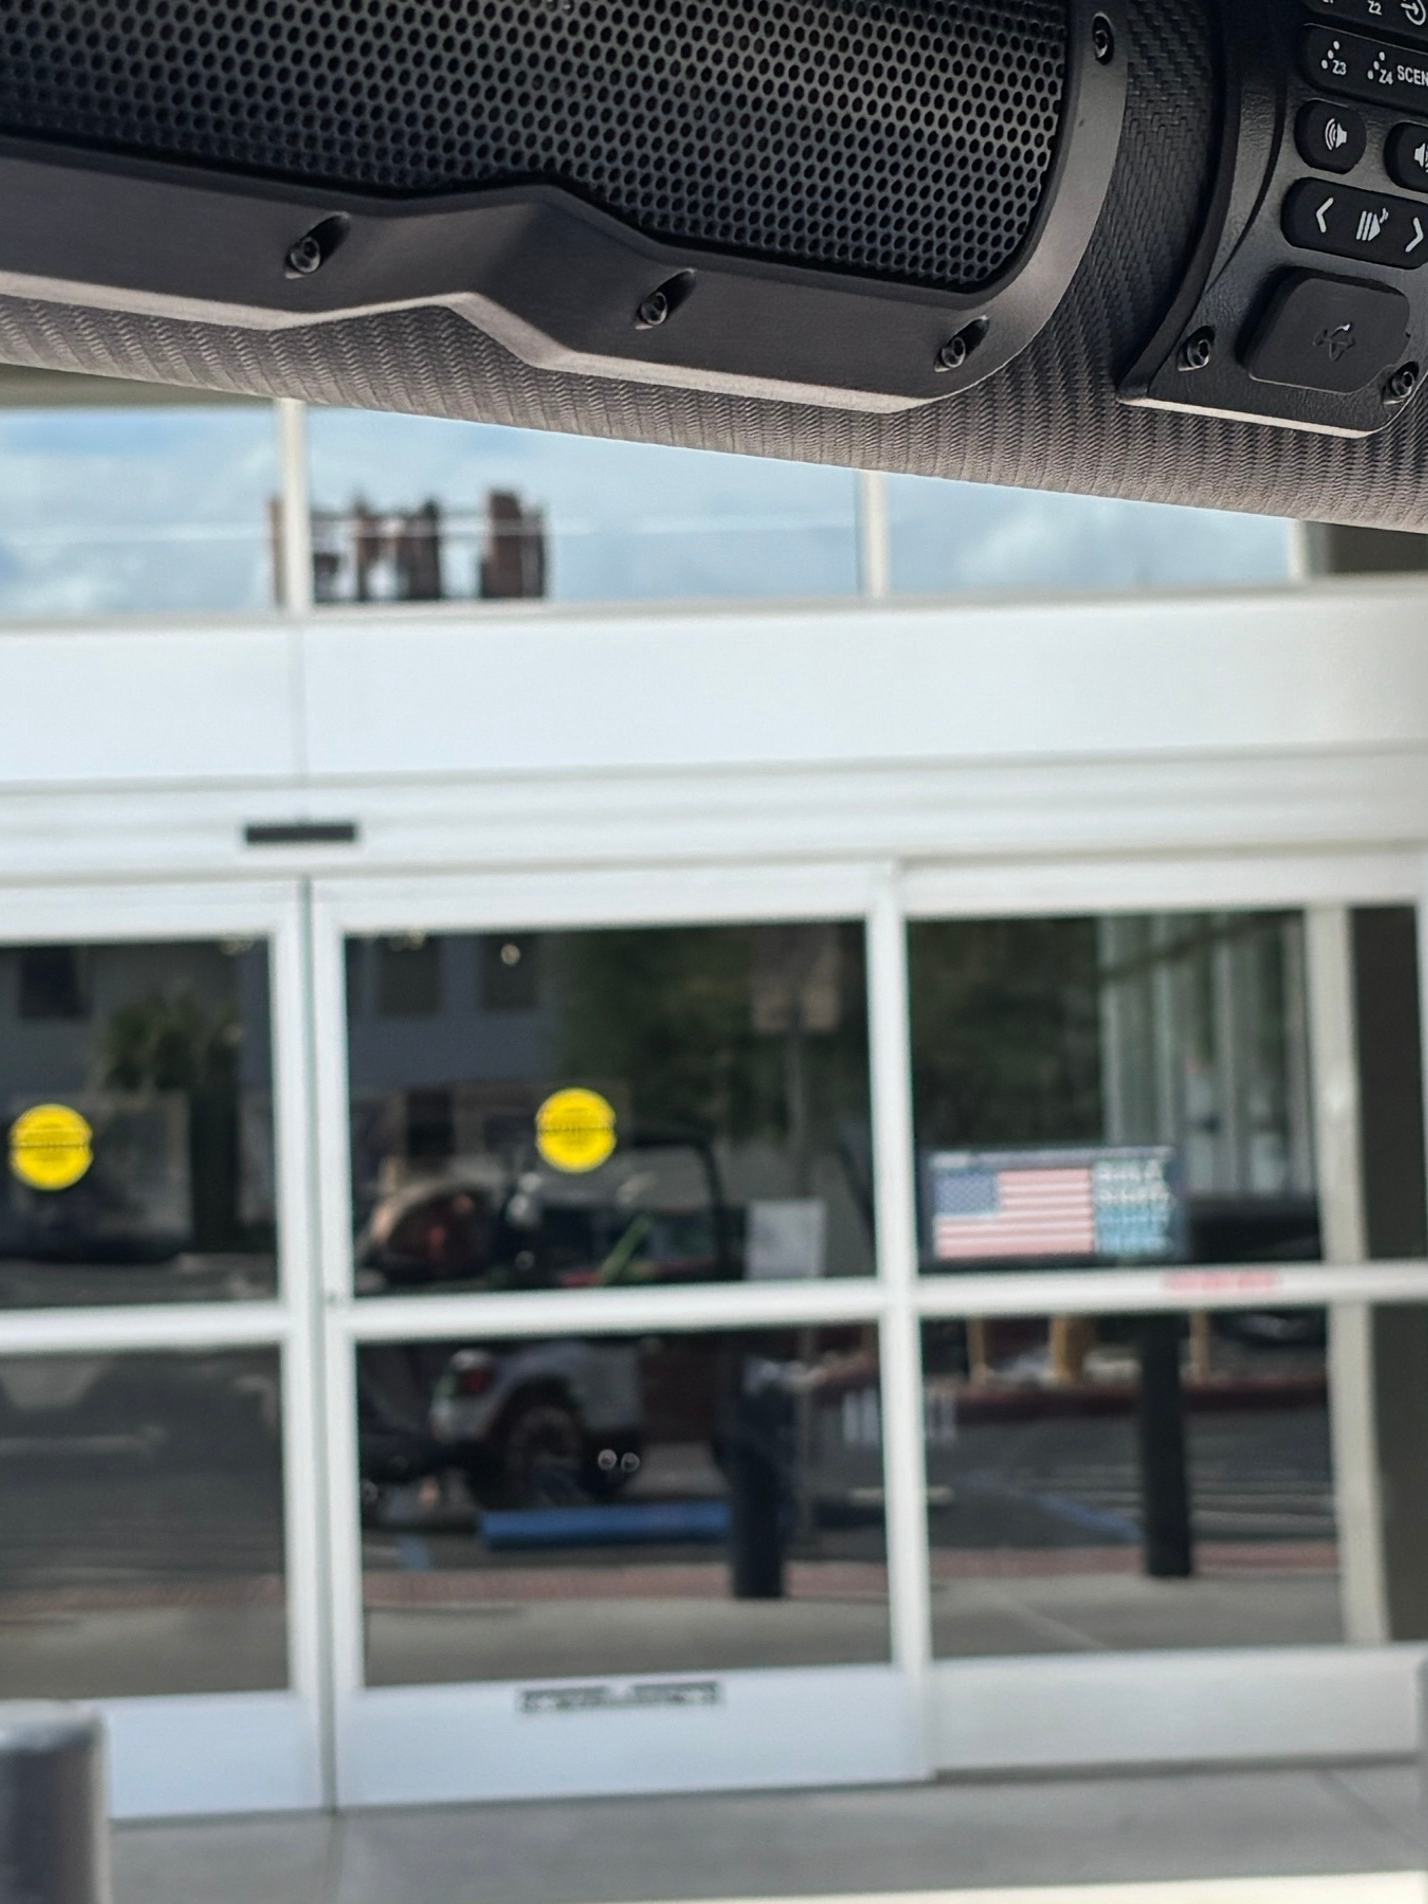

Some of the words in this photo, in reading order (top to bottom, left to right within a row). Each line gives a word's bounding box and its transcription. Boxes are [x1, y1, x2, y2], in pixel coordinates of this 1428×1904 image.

[1367, 0, 1383, 16] Z2
[1332, 59, 1347, 76] Z3
[1378, 69, 1394, 85] Z4
